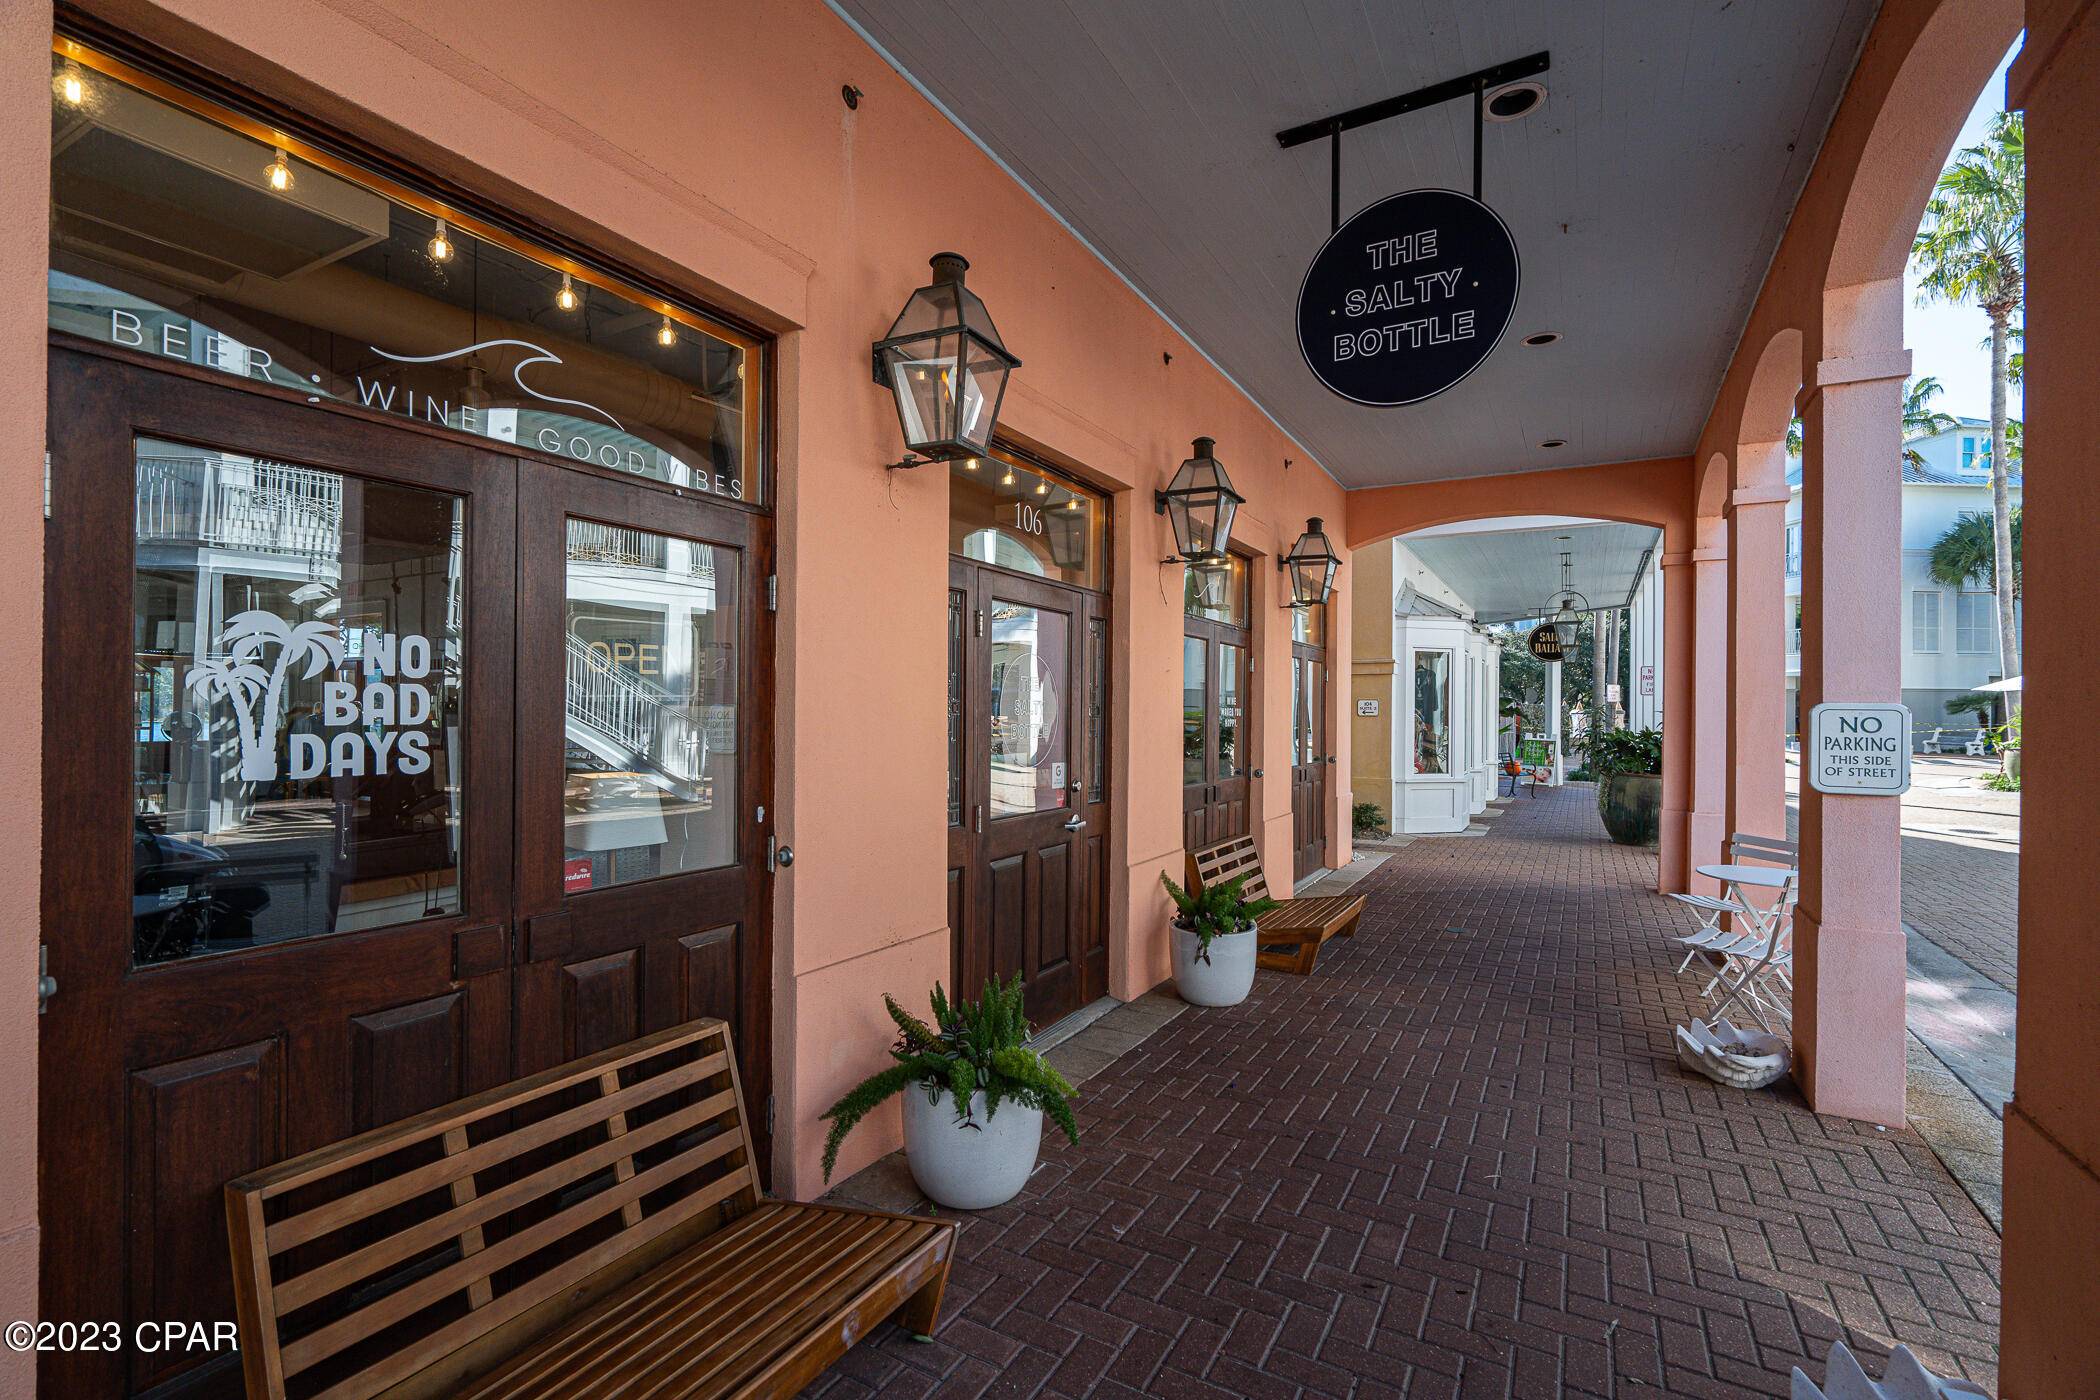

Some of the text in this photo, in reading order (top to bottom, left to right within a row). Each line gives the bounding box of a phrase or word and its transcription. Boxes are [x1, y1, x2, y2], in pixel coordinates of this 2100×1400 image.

[1366, 229, 1438, 270] THE
[1345, 268, 1463, 317] SALTY
[1333, 310, 1475, 362] BOTTLE
[112, 309, 273, 382] BEER
[356, 375, 478, 434] WINE
[538, 428, 645, 474] GOOD
[1015, 502, 1042, 536] 106
[363, 633, 431, 678] NO
[324, 681, 431, 727] BAD
[1839, 716, 1883, 733] NO
[290, 730, 431, 780] DAYS
[1824, 736, 1897, 752] PARKING
[1830, 755, 1892, 766] THIS SIDE
[1825, 767, 1897, 778] OF STREET
